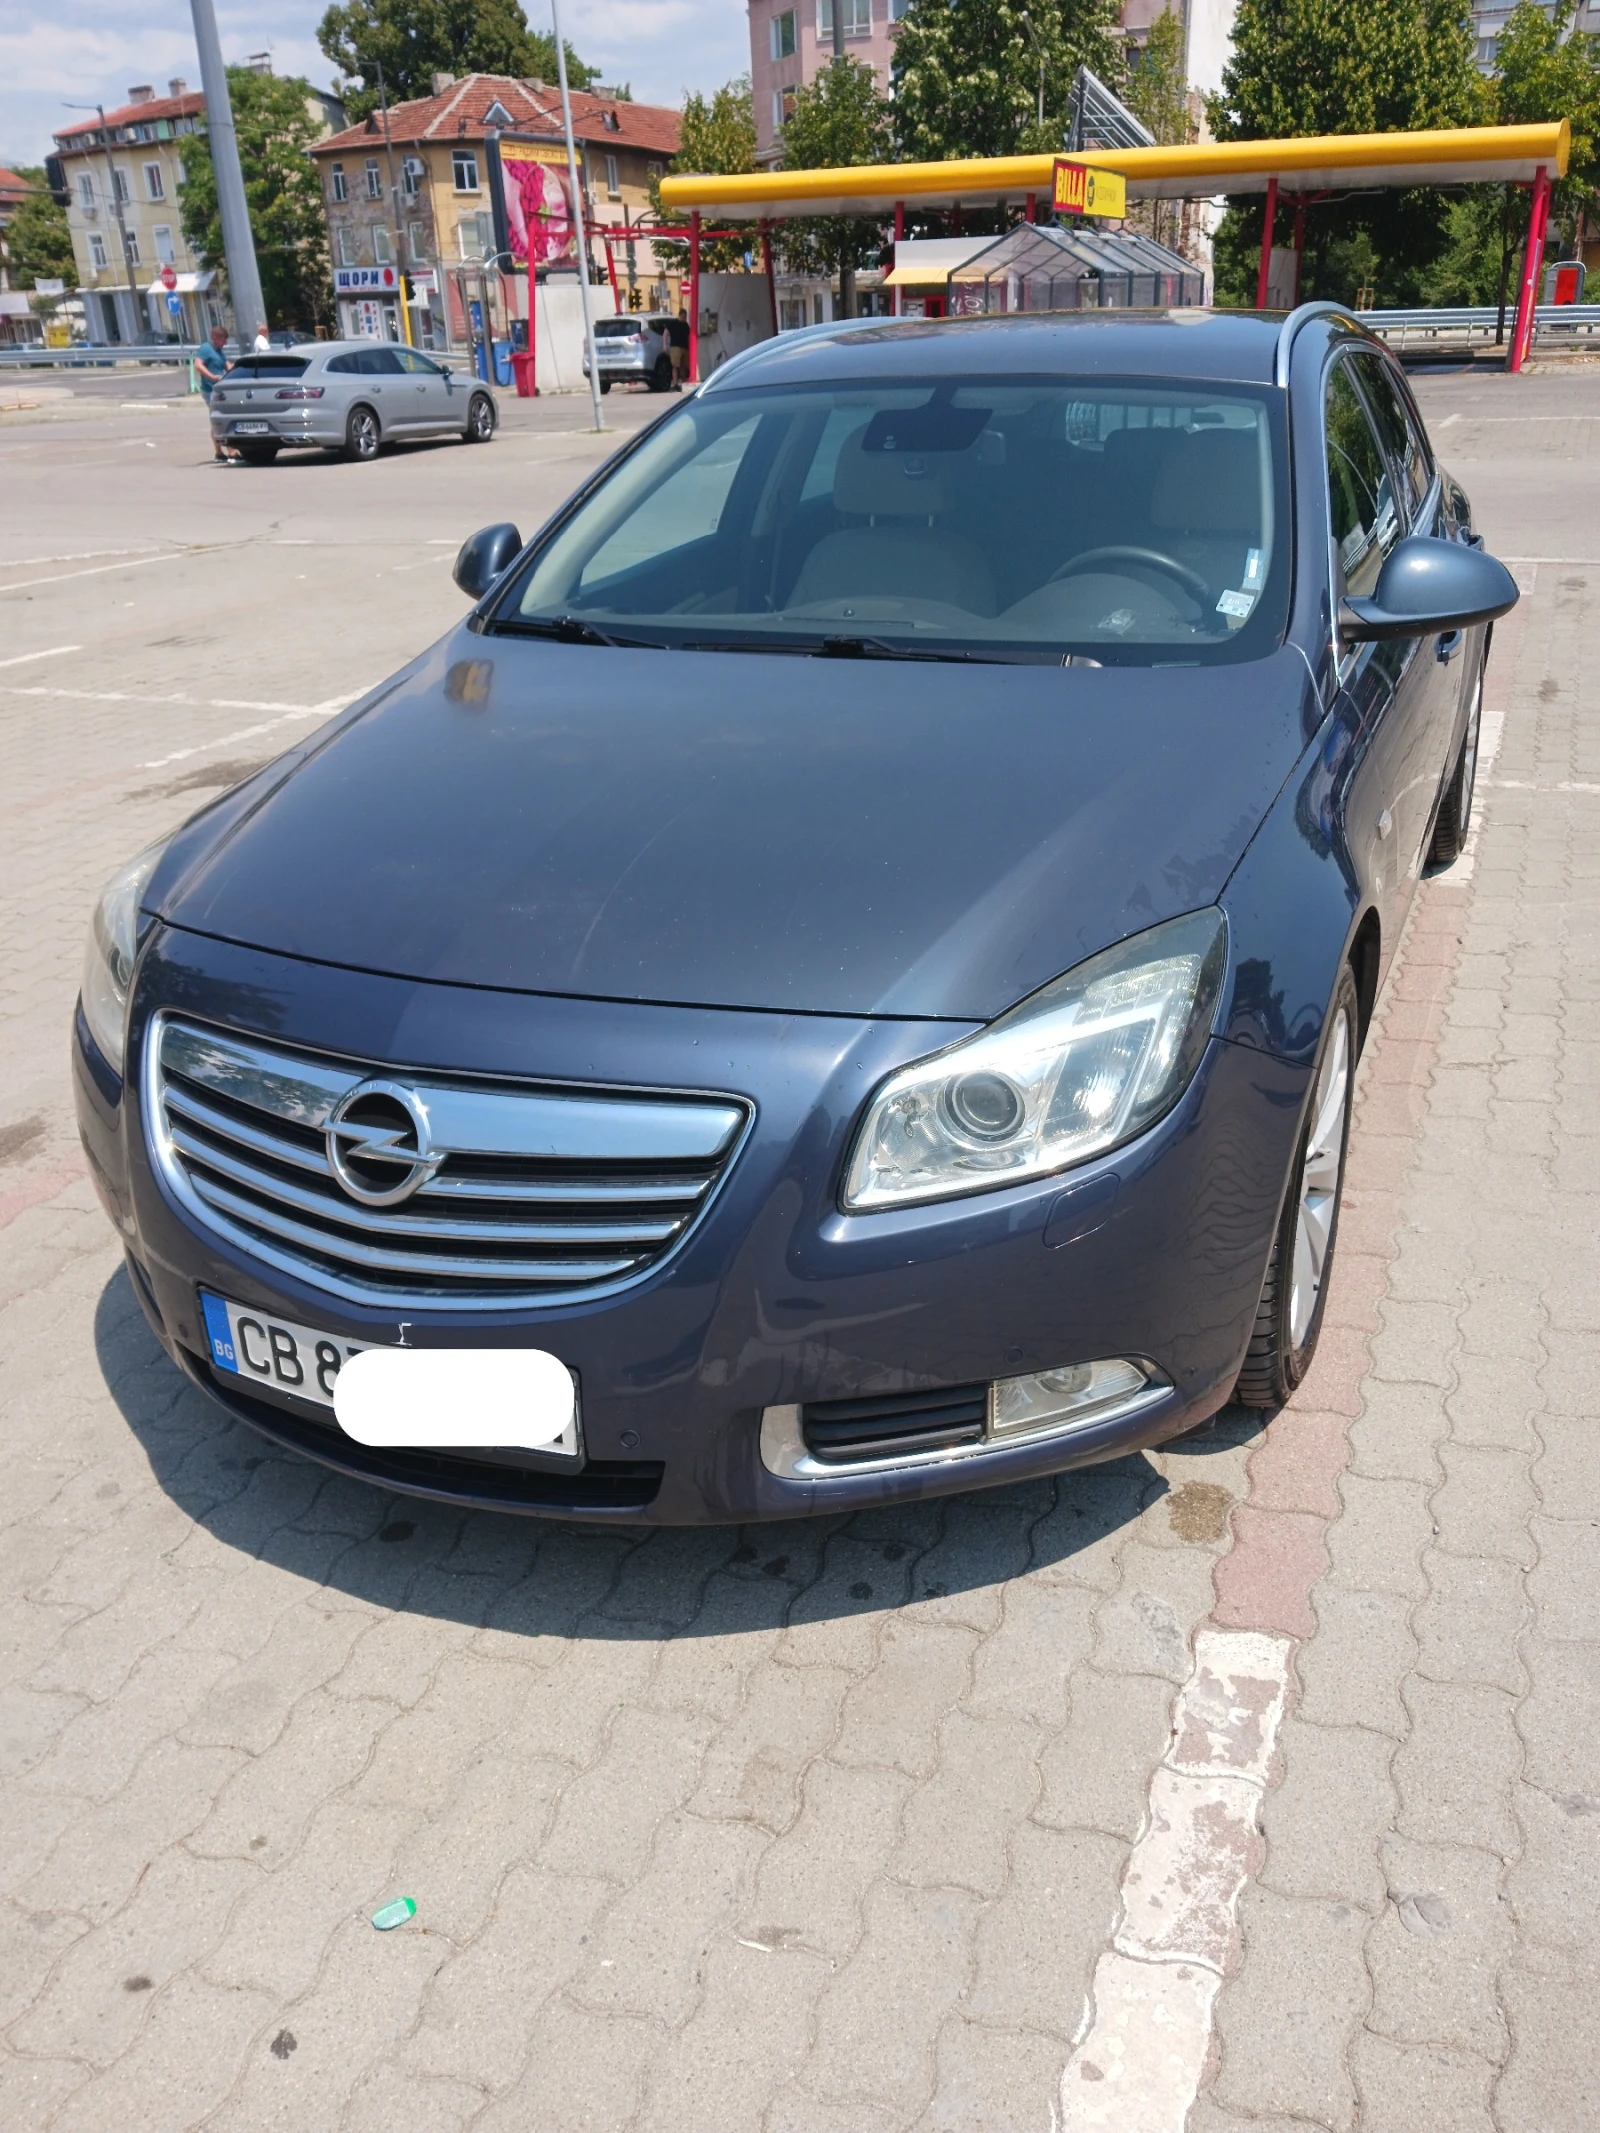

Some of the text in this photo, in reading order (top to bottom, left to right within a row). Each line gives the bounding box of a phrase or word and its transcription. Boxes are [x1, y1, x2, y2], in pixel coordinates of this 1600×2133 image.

[1056, 167, 1083, 206] BILLA
[338, 271, 379, 287] ЩОРИ
[214, 1339, 234, 1360] BG
[237, 1317, 304, 1386] CB
